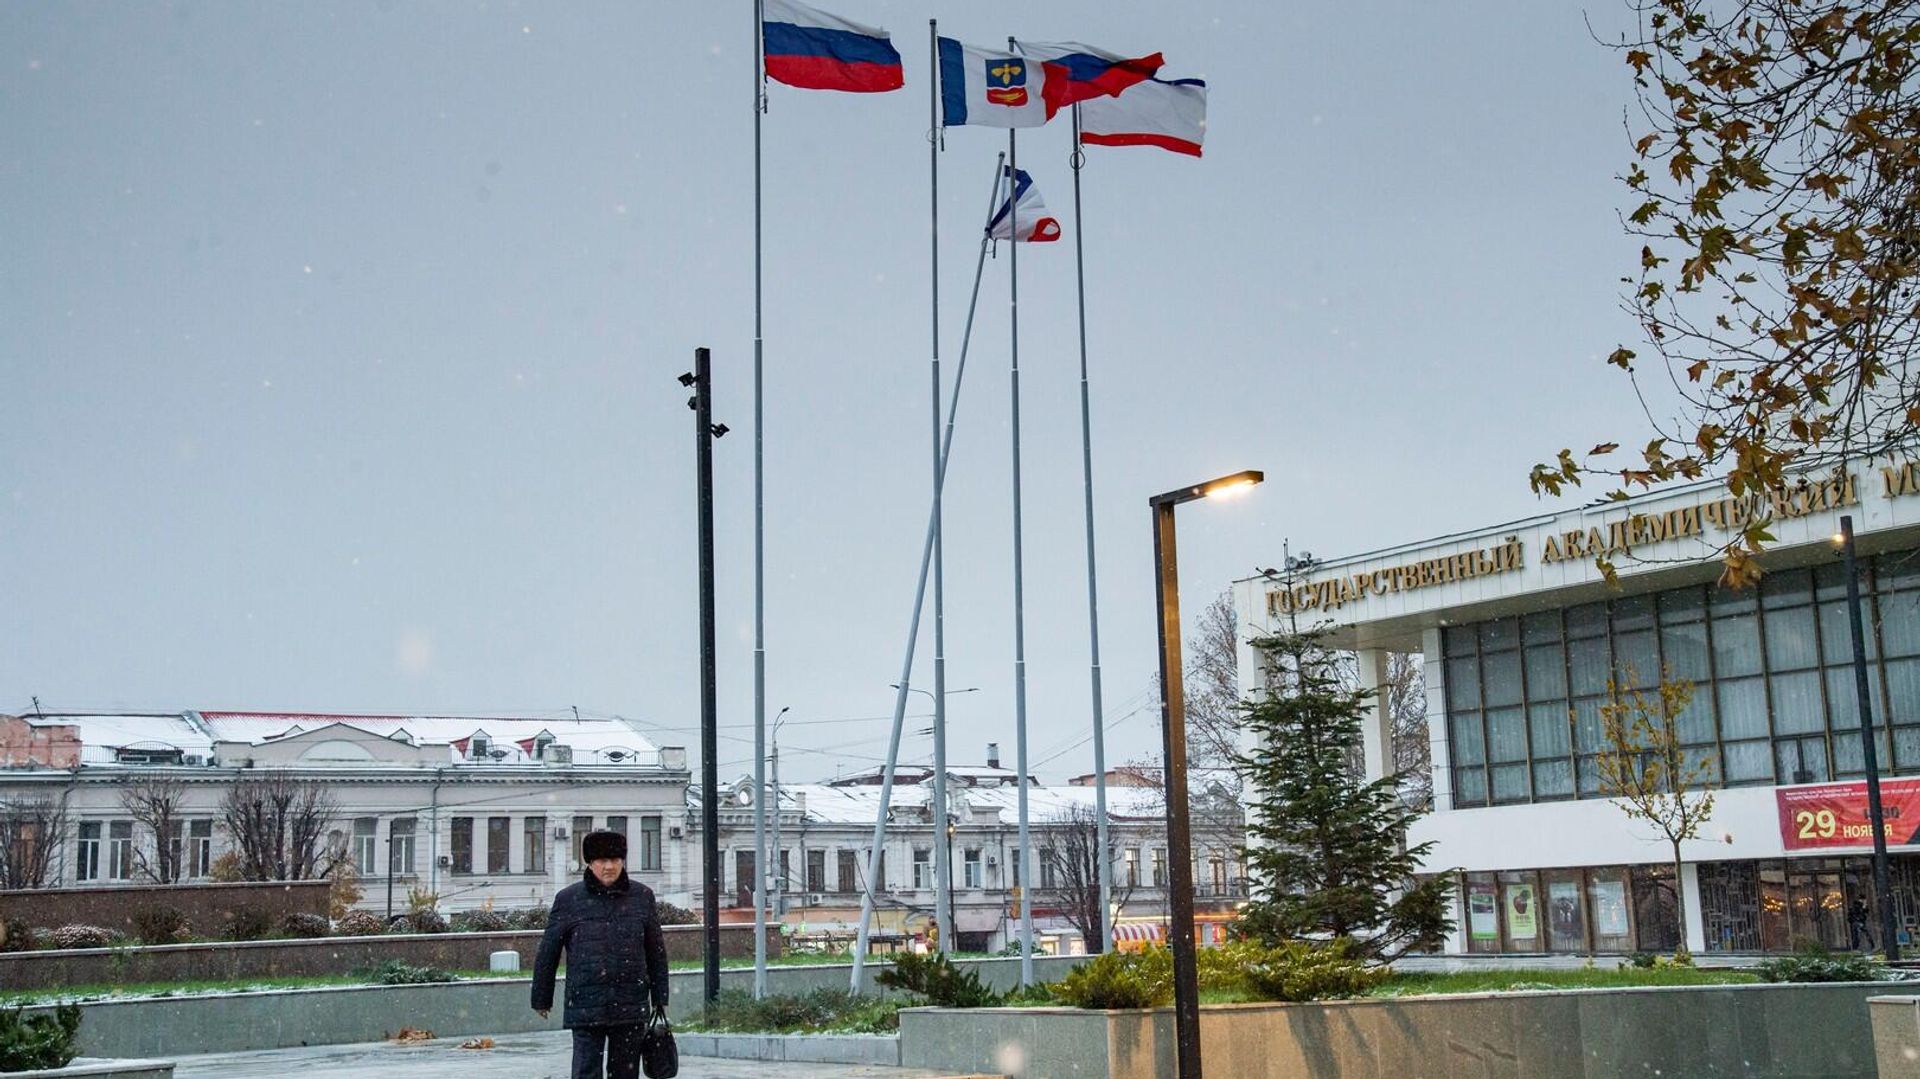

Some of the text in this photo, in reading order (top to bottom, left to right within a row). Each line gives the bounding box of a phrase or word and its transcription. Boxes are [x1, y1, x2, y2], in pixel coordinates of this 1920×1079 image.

[1265, 535, 1523, 617] ГОСУДАРСТВЕННЫЙ
[1796, 810, 1893, 838] 29 НОЯБЯ
